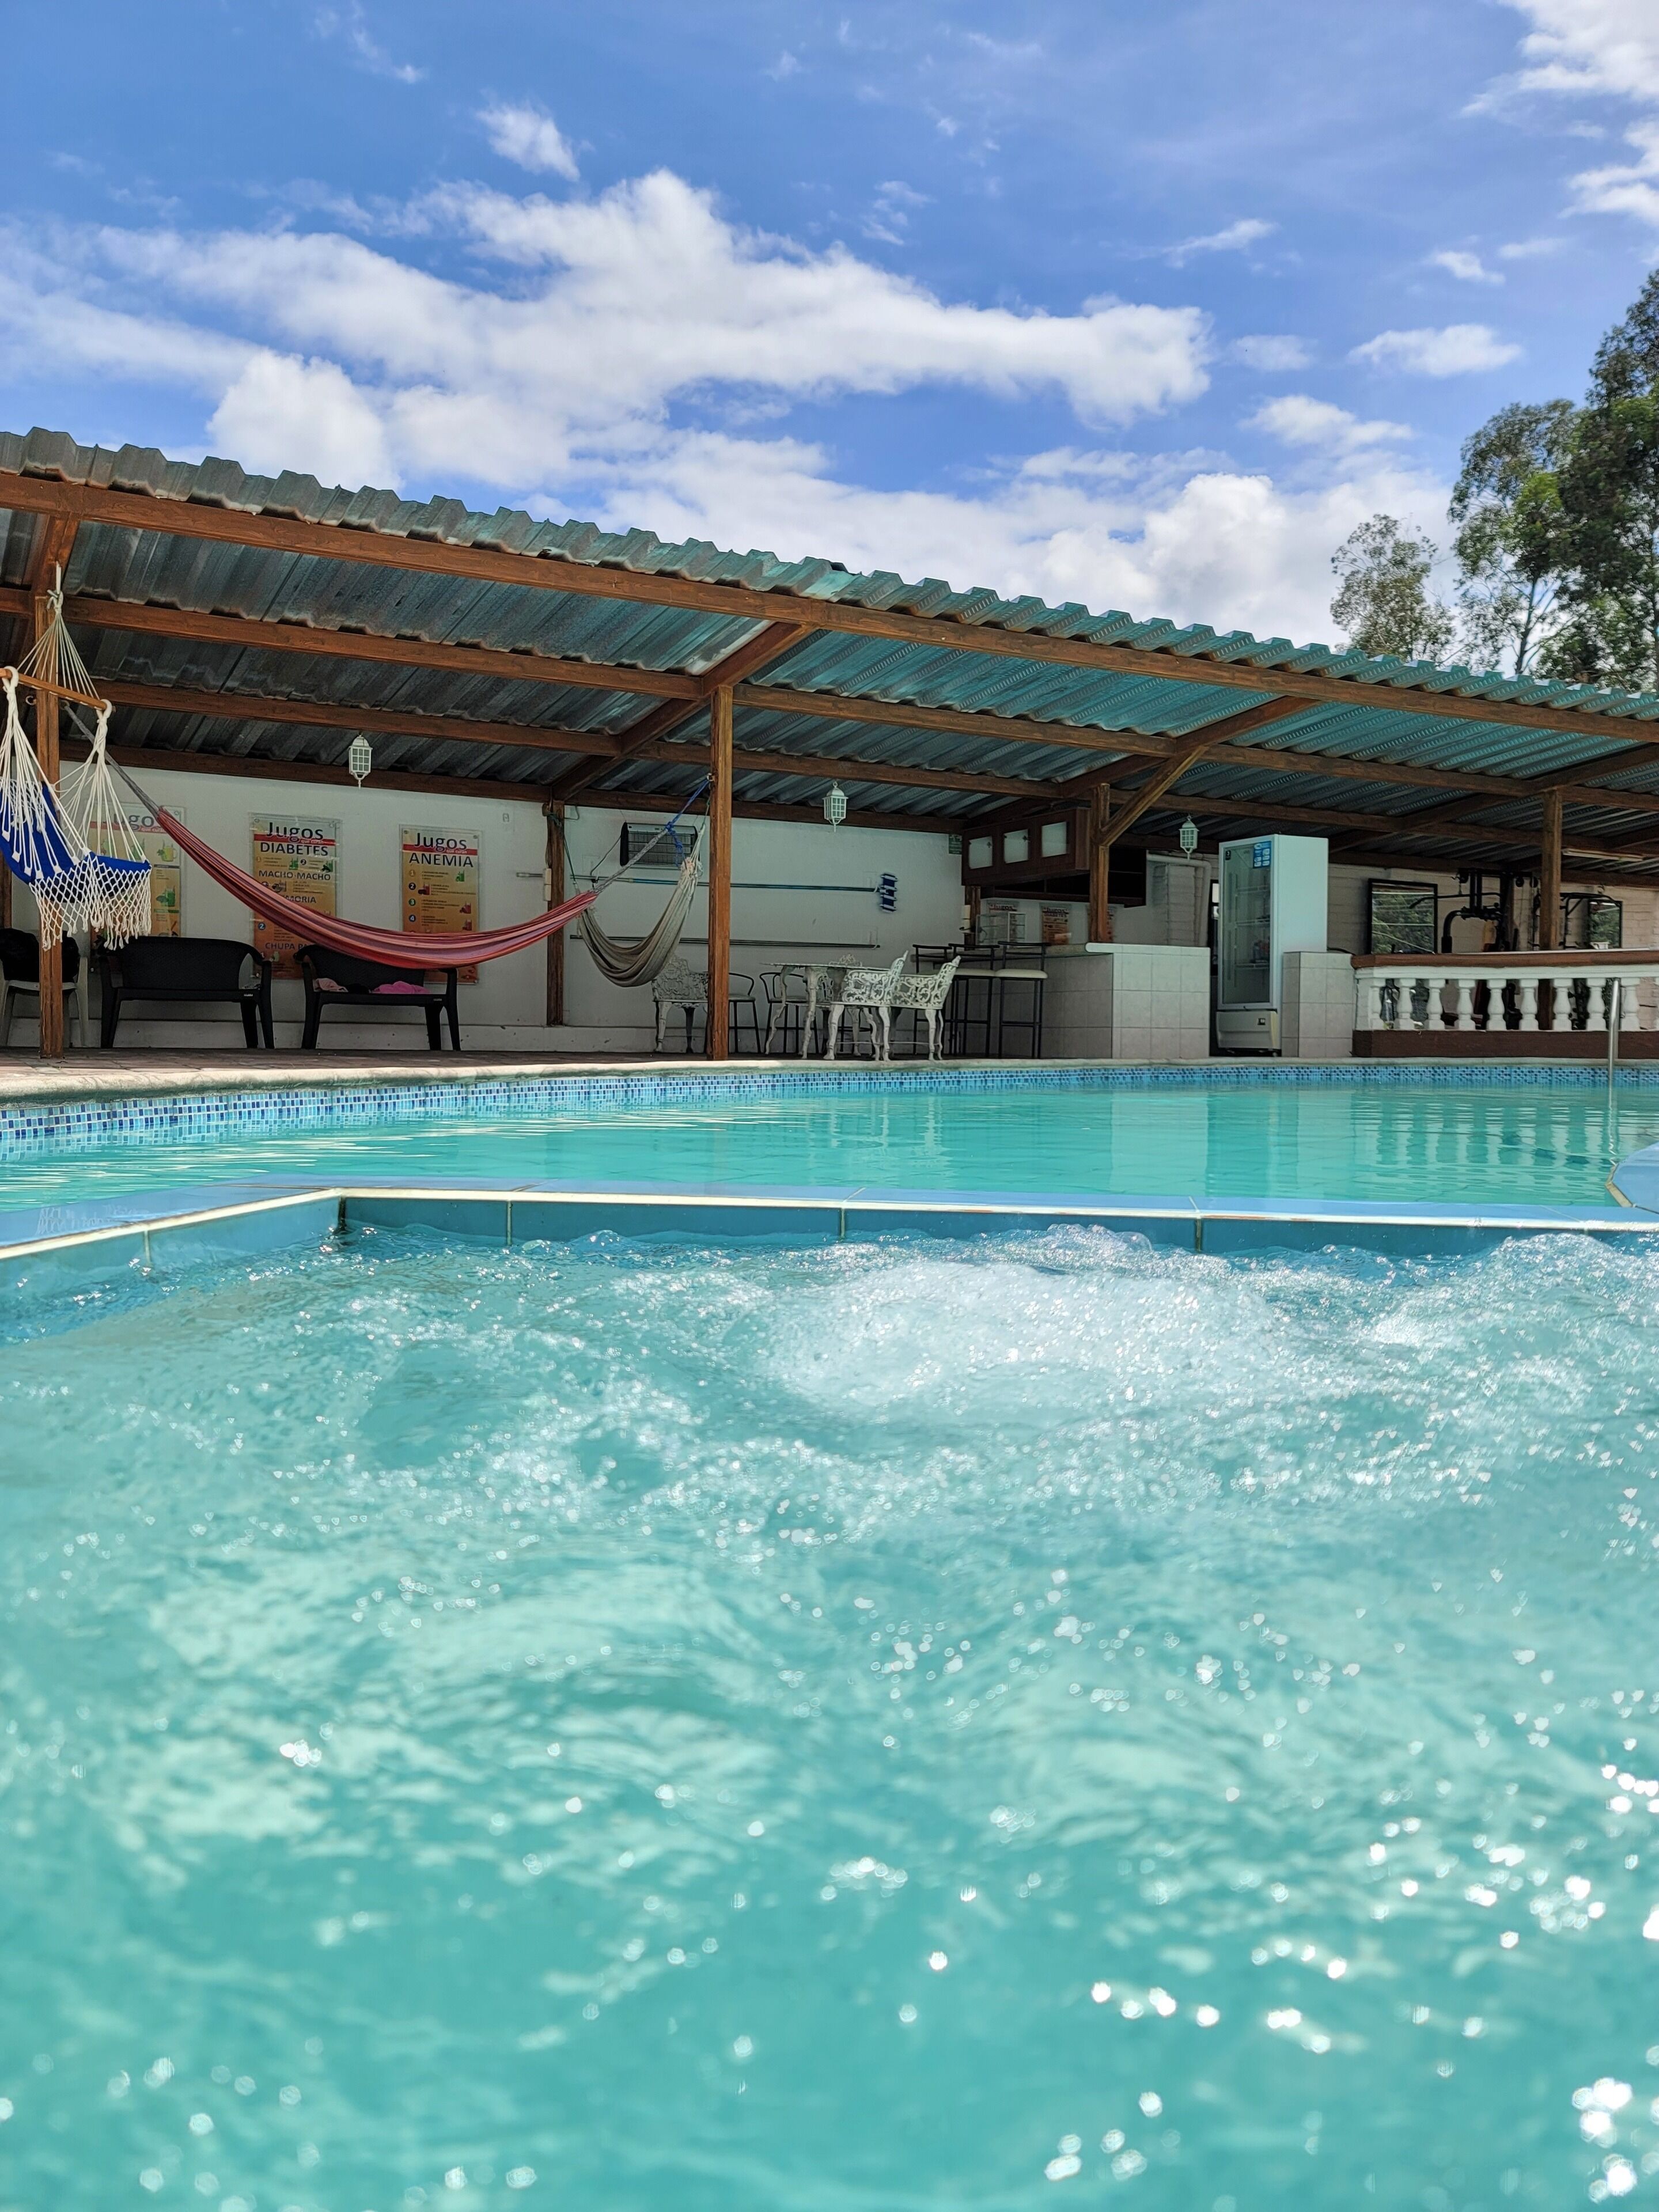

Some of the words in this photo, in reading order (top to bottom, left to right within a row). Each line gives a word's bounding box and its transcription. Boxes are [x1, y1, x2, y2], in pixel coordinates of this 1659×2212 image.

[266, 822, 324, 843] Jugos
[260, 842, 328, 856] DIABETES
[414, 832, 467, 852] Jugos
[409, 853, 474, 868] ANEMIA
